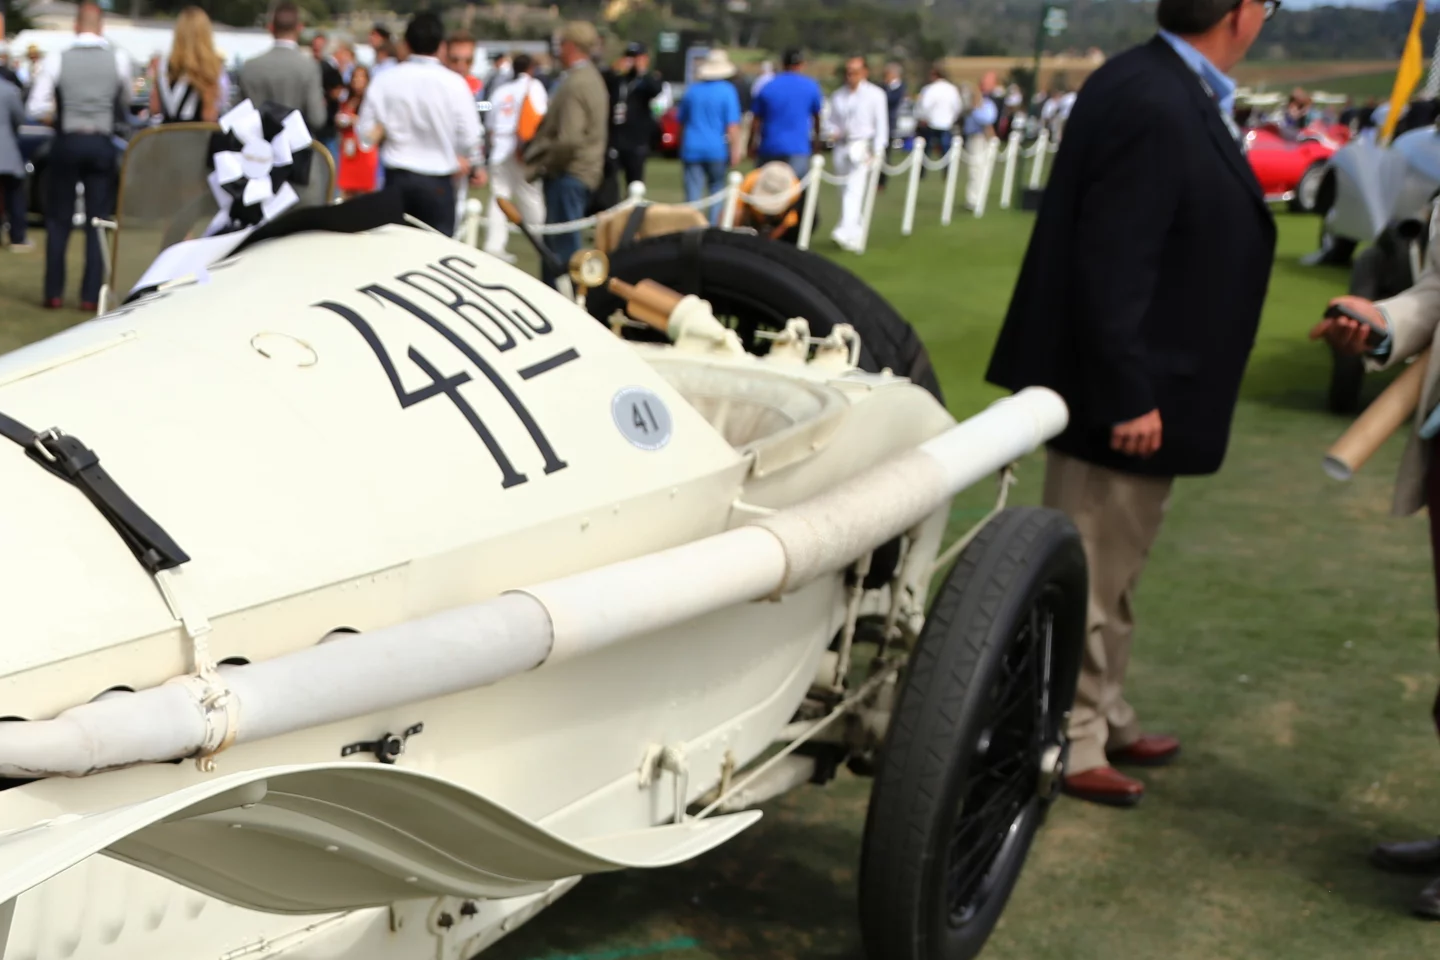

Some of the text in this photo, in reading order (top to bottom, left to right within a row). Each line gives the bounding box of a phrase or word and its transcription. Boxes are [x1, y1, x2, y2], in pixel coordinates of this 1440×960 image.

[311, 256, 569, 489] 41 BIS
[631, 399, 659, 435] 41
